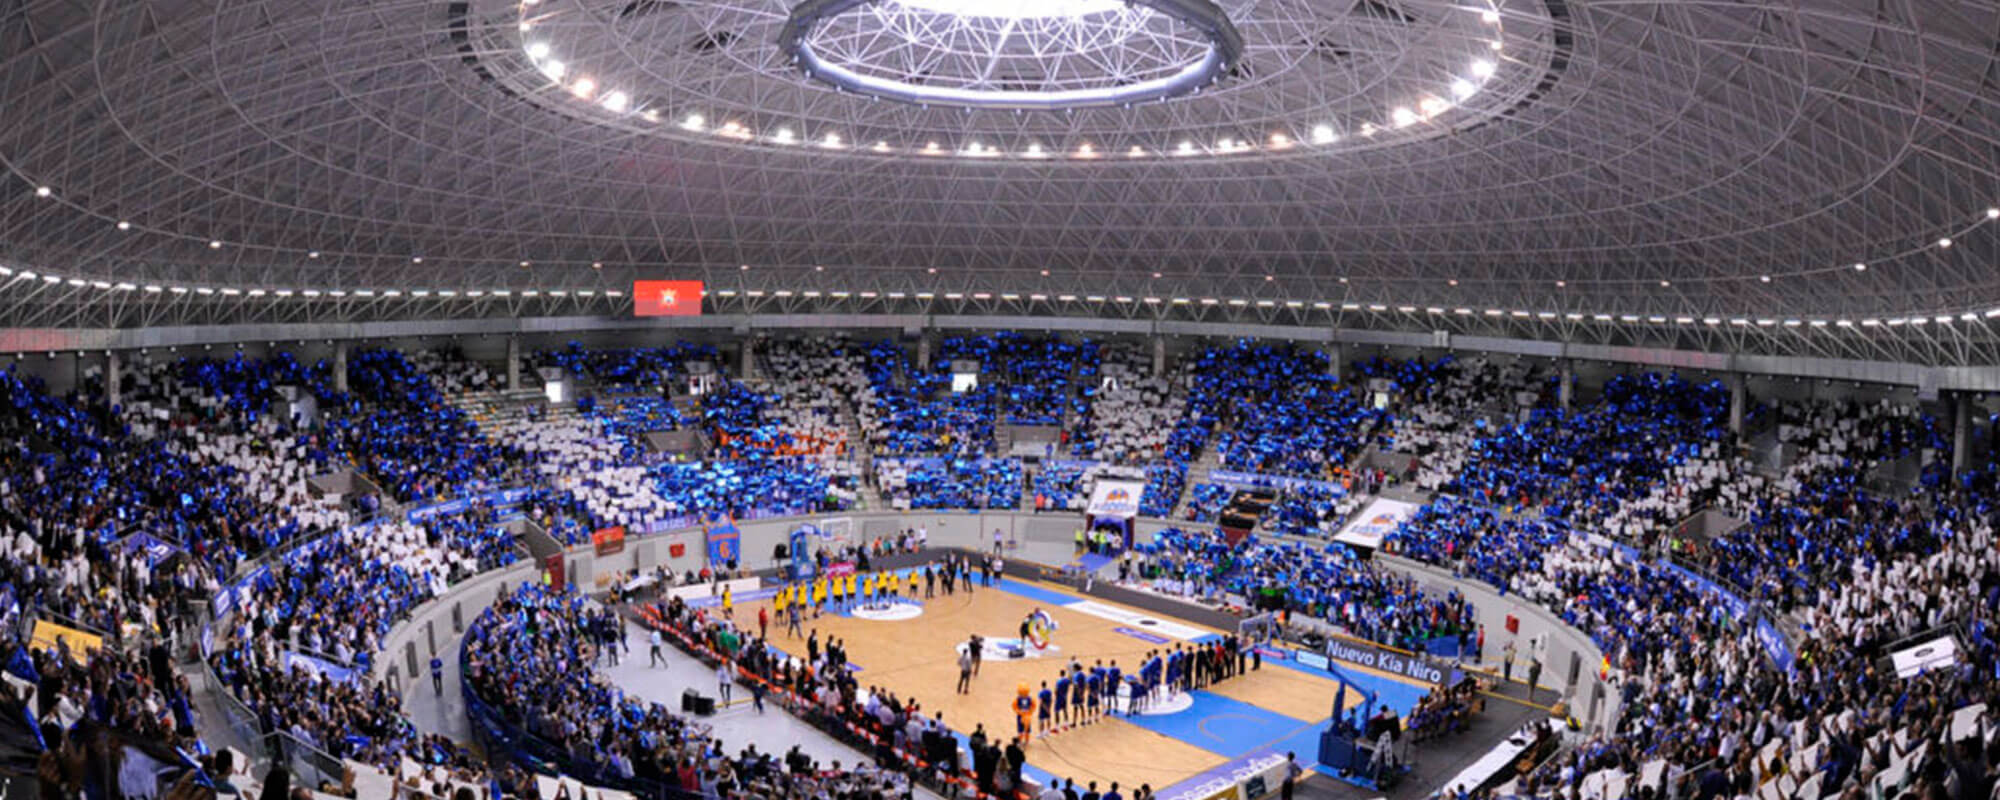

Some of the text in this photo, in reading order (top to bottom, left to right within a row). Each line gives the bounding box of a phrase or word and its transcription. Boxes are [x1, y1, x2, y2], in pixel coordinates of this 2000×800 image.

[1326, 640, 1375, 666] Nuevo
[1378, 652, 1403, 673] Kia
[1407, 660, 1442, 683] Niro
